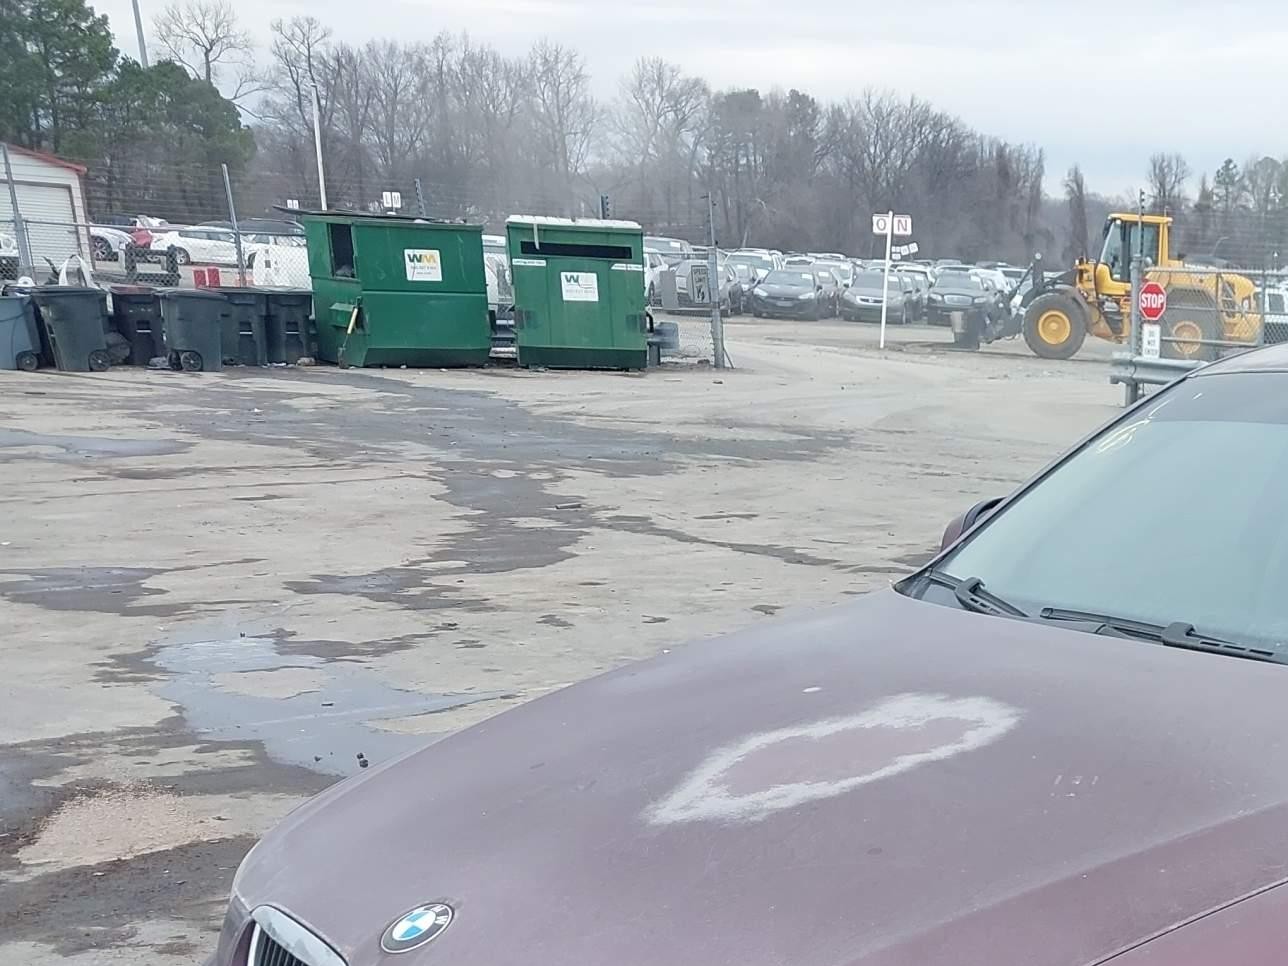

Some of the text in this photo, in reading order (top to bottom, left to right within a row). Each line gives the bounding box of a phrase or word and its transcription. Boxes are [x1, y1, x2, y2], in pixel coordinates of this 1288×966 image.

[876, 217, 887, 231] O
[897, 219, 908, 232] N
[407, 253, 437, 263] WM
[1141, 292, 1164, 308] STOP
